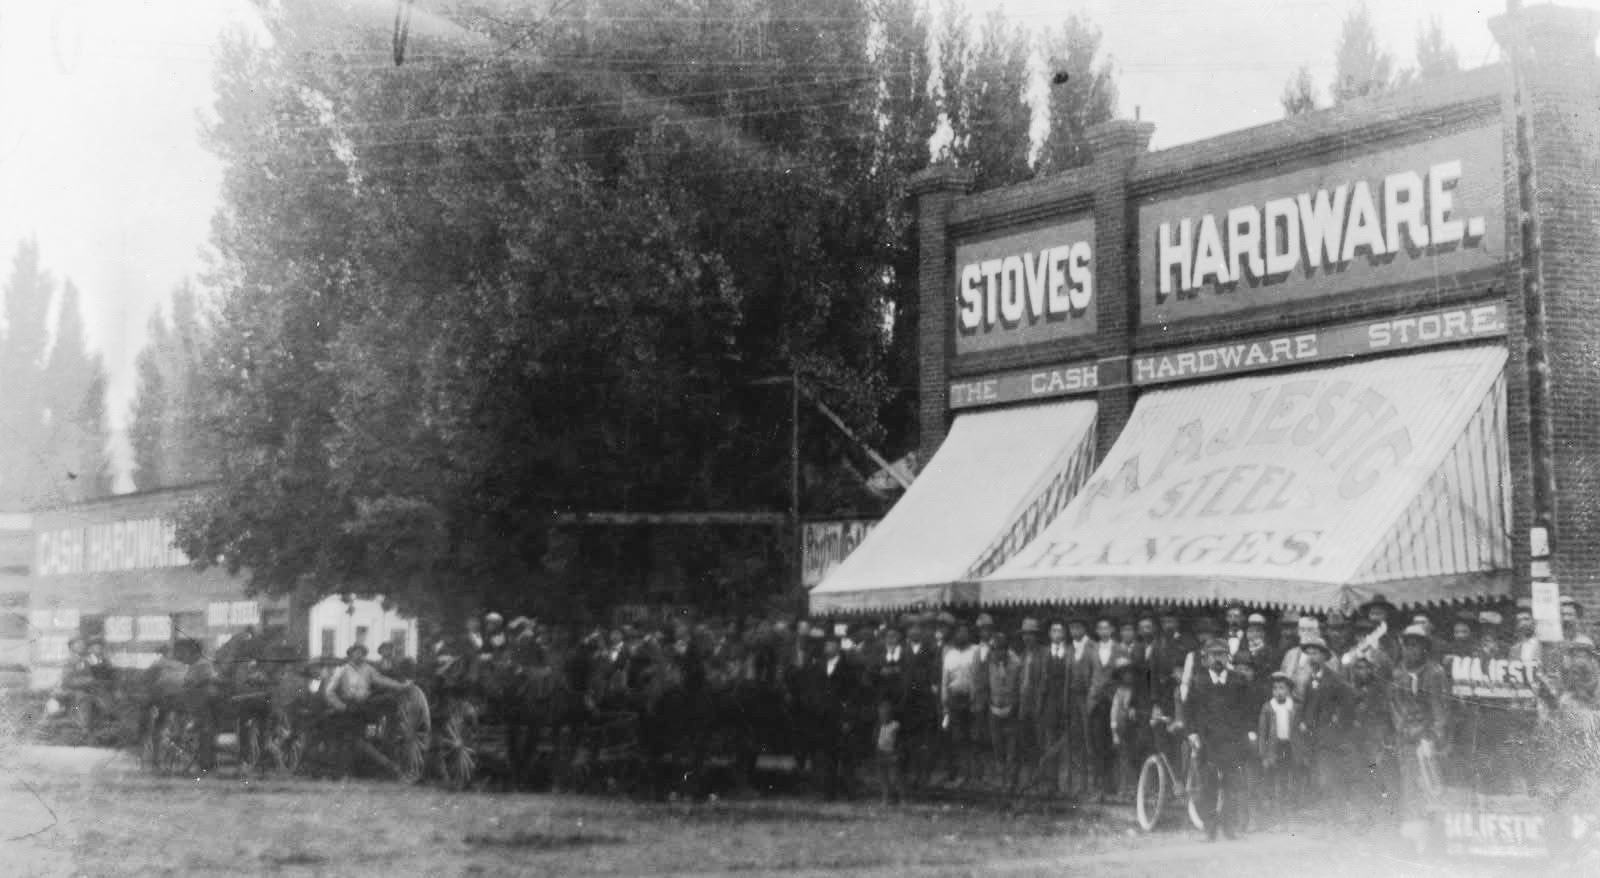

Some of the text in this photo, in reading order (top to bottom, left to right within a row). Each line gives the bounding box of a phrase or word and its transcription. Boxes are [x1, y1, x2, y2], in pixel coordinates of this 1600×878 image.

[1159, 160, 1486, 294] HARDWARE.
[960, 241, 1093, 329] STOVES
[950, 306, 1504, 403] THE CASH HARDWARE STORE.
[1073, 386, 1413, 528] MAJESTIC
[1148, 463, 1297, 520] STEEL
[90, 518, 189, 573] HARDWAR
[1028, 528, 1325, 571] RANGES.
